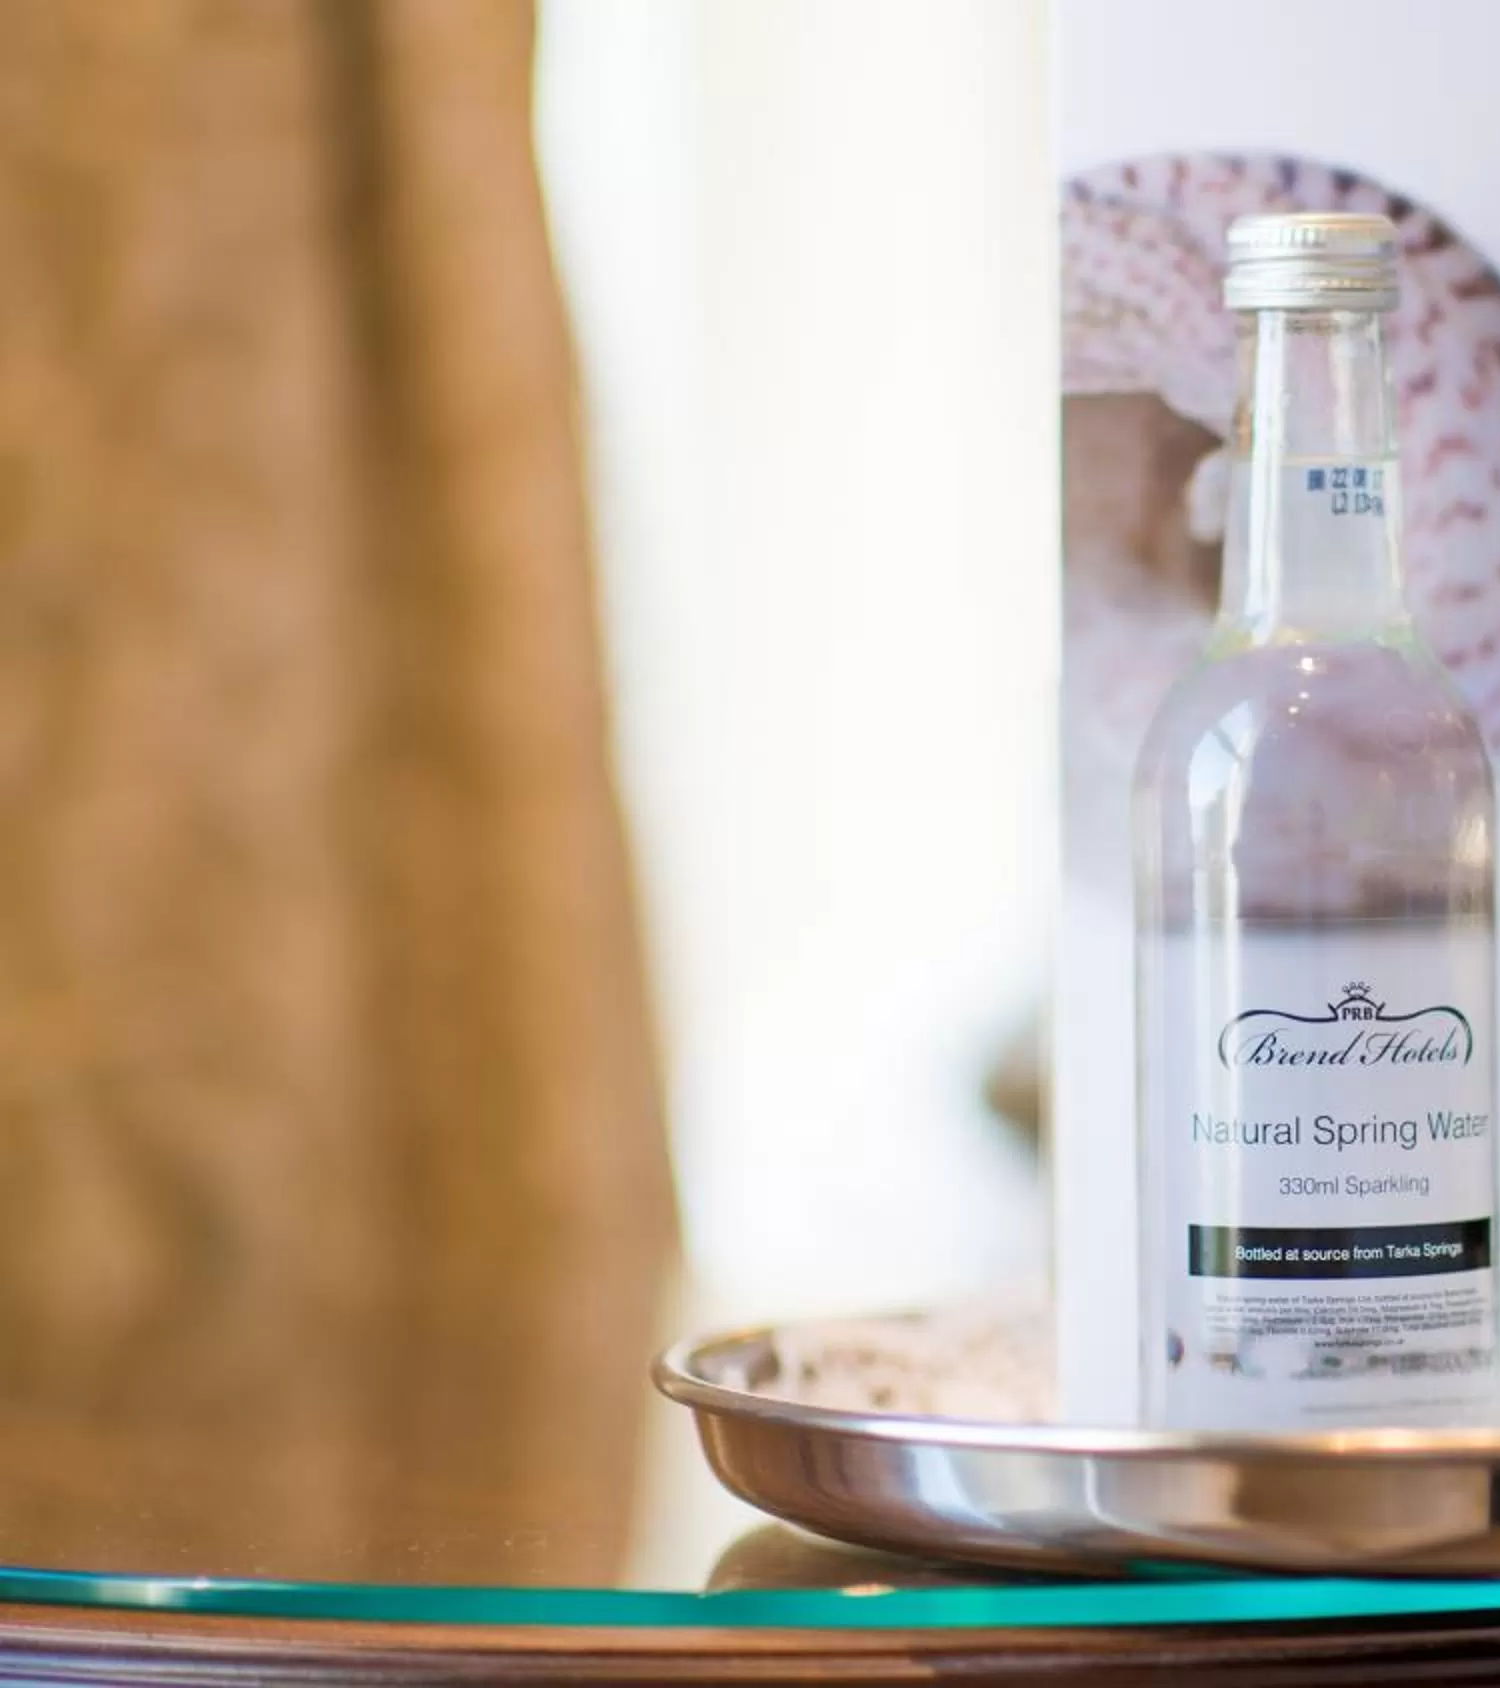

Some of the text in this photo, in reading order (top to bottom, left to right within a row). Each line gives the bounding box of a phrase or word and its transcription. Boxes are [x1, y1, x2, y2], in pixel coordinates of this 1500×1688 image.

[1341, 1006, 1373, 1021] PRB
[1234, 1025, 1458, 1066] Brend Hotels
[1192, 1110, 1489, 1151] Natural Spring Water
[1279, 1174, 1429, 1197] 330ml Sparkling
[1235, 1241, 1463, 1262] Bottled at source from Tarka Springs
